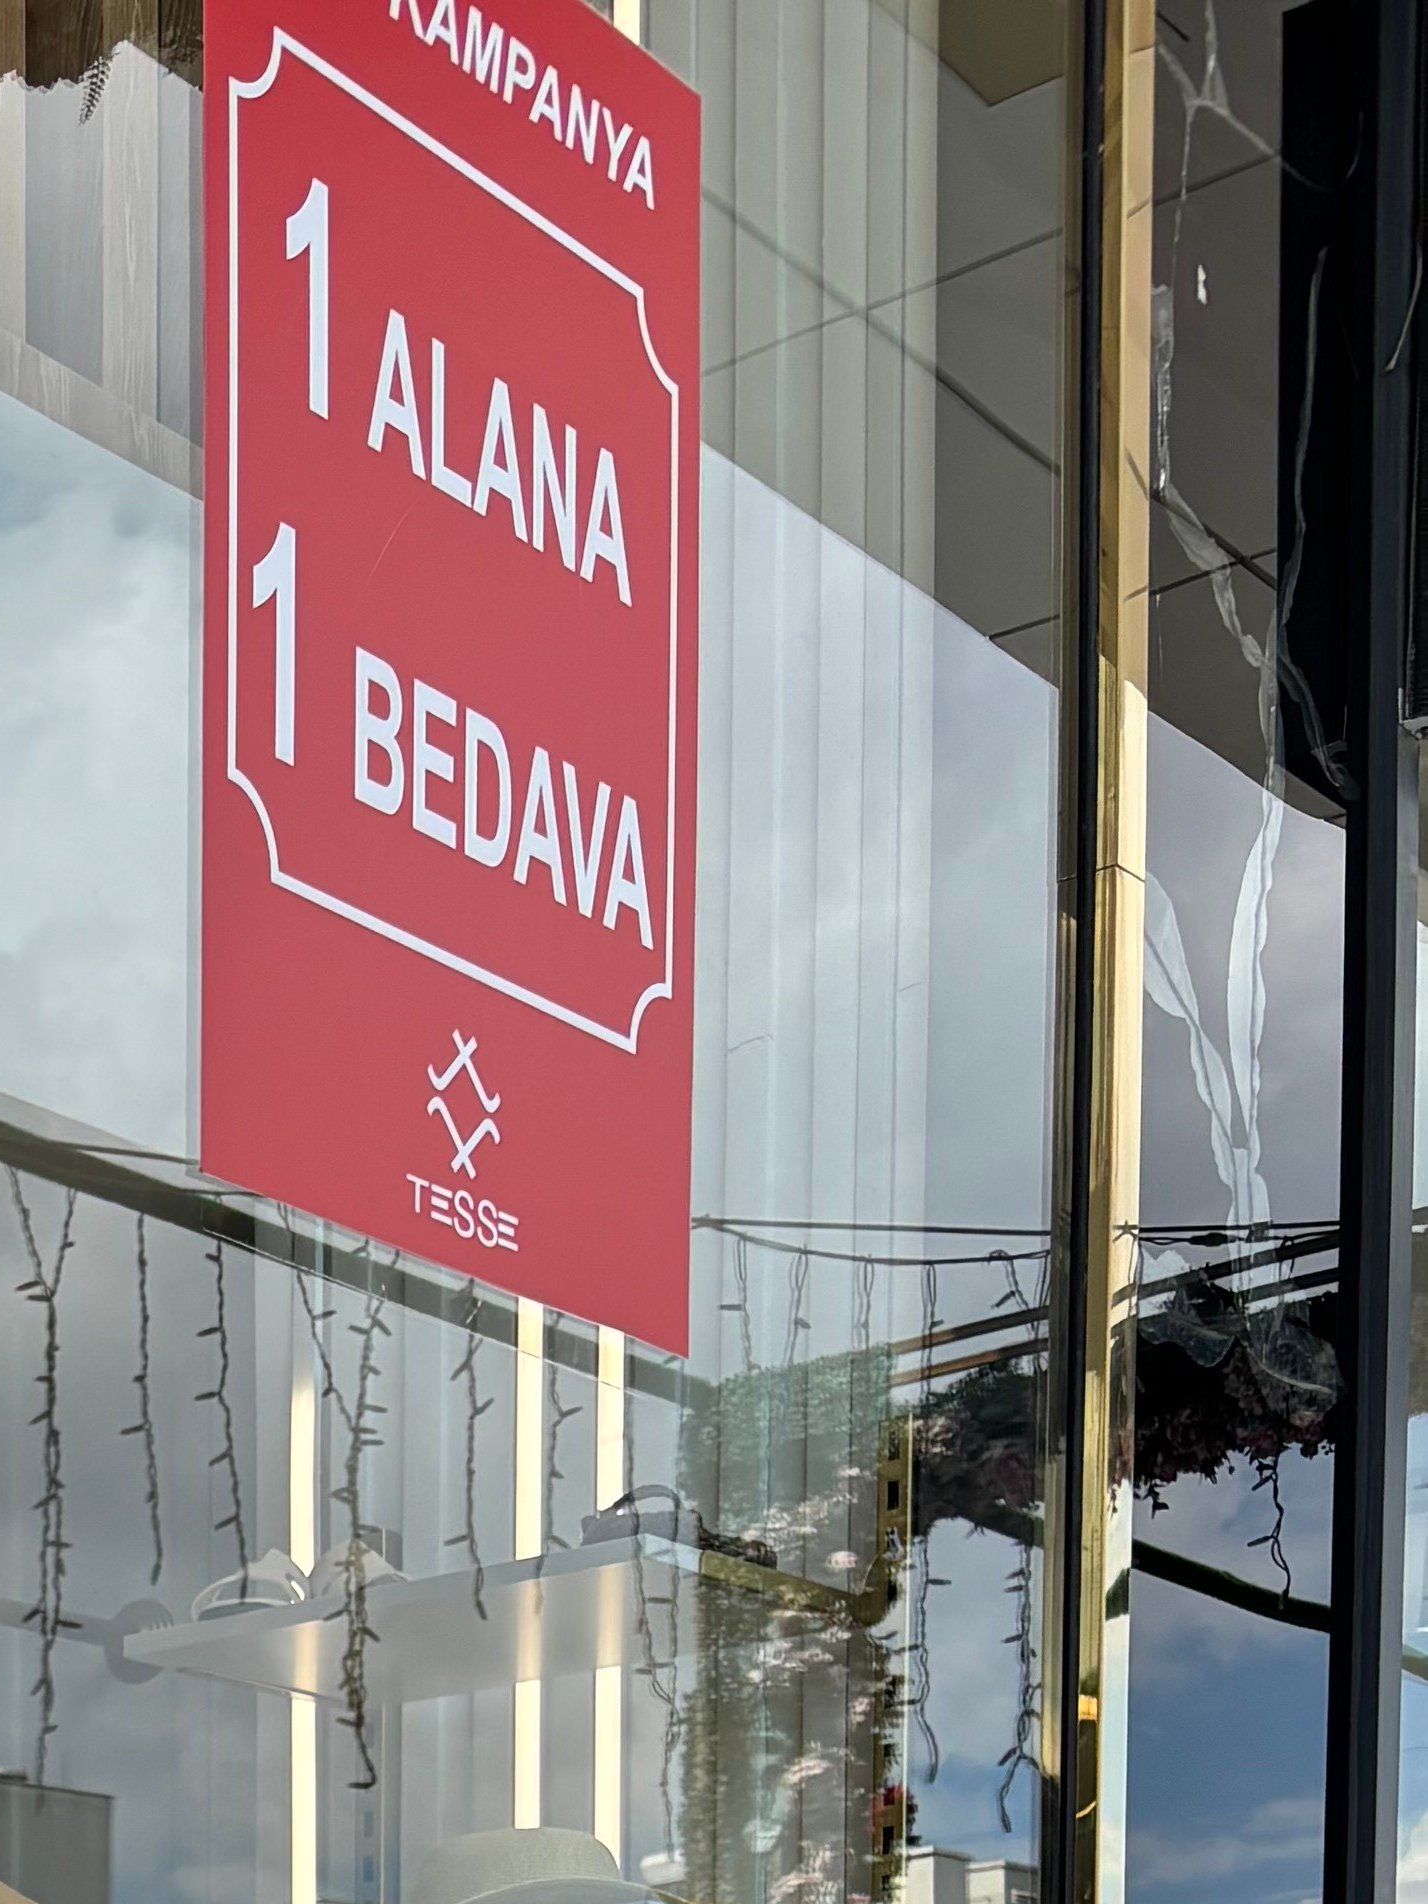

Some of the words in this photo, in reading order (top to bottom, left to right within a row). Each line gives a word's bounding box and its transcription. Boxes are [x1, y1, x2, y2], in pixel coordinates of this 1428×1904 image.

[286, 178, 328, 419] 1
[368, 309, 632, 607] ALANA
[253, 522, 296, 766] 1
[355, 646, 653, 950] BEDAVA
[406, 1174, 518, 1251] TESSE
